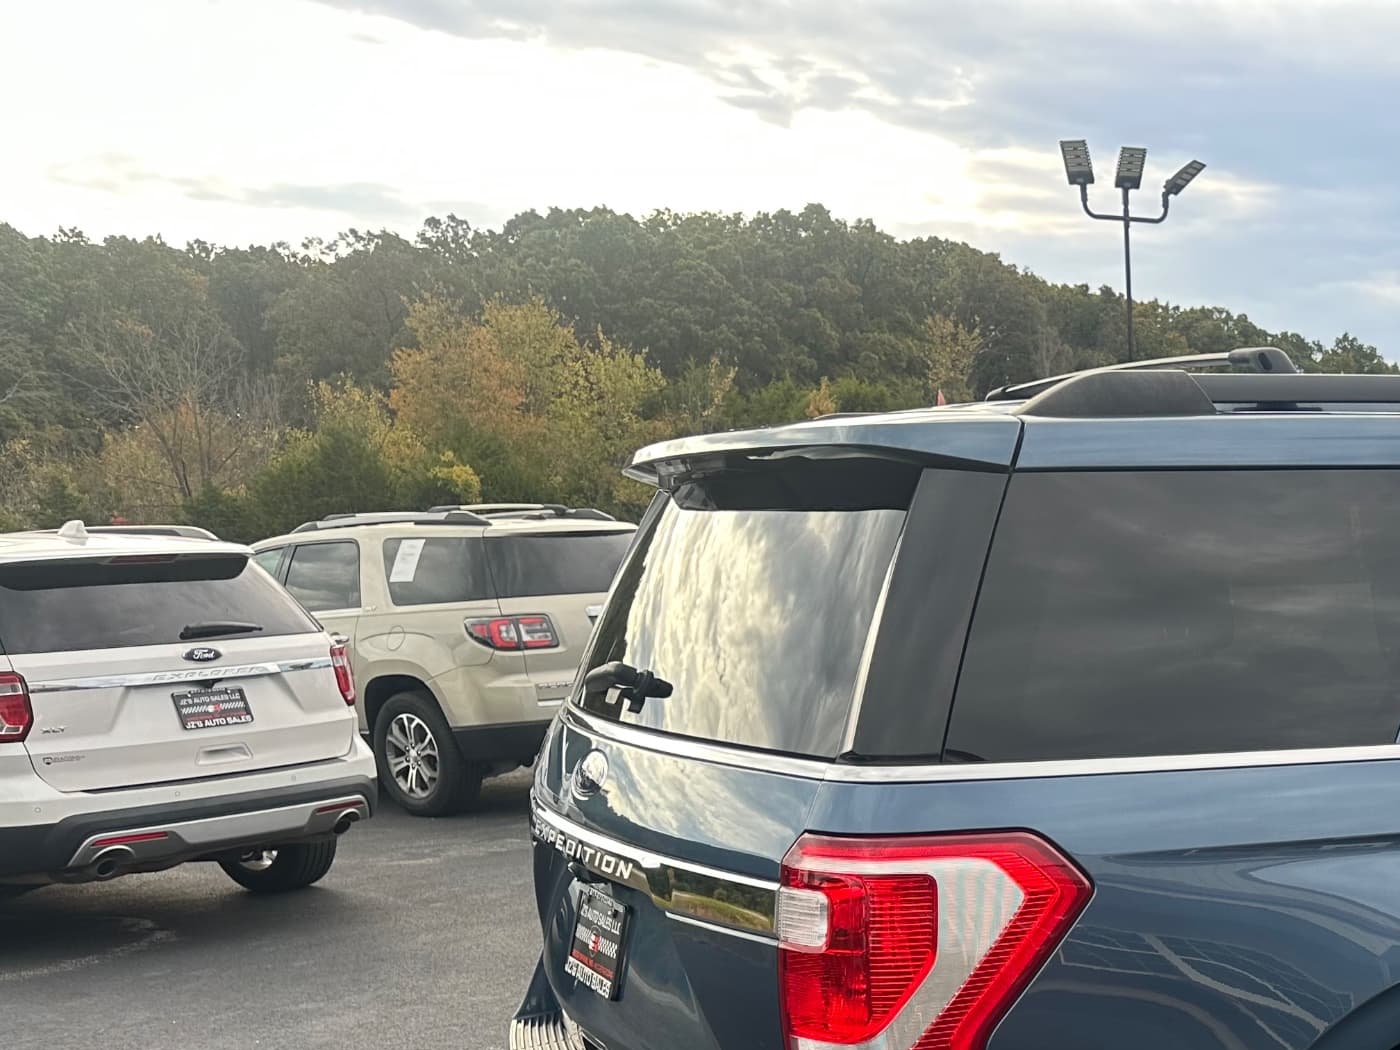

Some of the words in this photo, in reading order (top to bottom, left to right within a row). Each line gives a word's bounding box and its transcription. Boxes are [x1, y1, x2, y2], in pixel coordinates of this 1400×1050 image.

[205, 718, 226, 726] AUTO
[227, 715, 252, 724] SALES
[535, 819, 633, 880] EXPEDITION
[576, 962, 592, 987] AUTO
[591, 973, 611, 999] SALES
